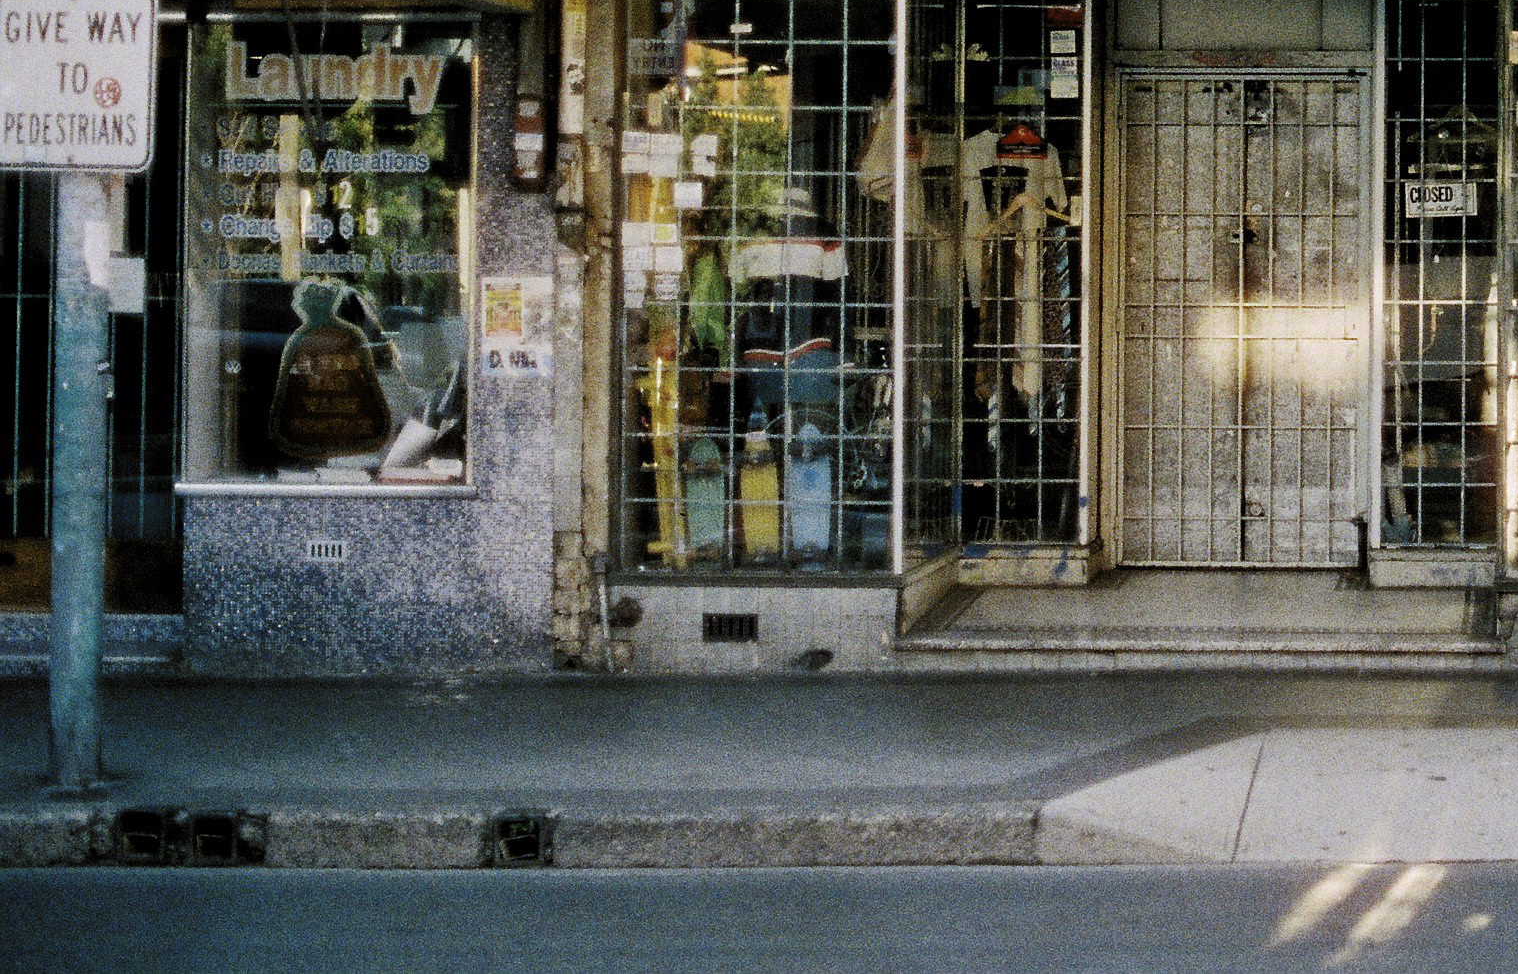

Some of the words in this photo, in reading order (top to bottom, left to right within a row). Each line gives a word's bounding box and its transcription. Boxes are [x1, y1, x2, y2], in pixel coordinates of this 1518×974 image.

[5, 11, 68, 44] GIVE
[87, 11, 143, 44] WAY
[57, 62, 88, 96] TO
[226, 41, 445, 114] Laundry
[4, 112, 137, 146] PEDESTRIANS
[299, 149, 317, 172] &
[322, 148, 431, 173] Alterations
[1410, 186, 1453, 203] CLOSED
